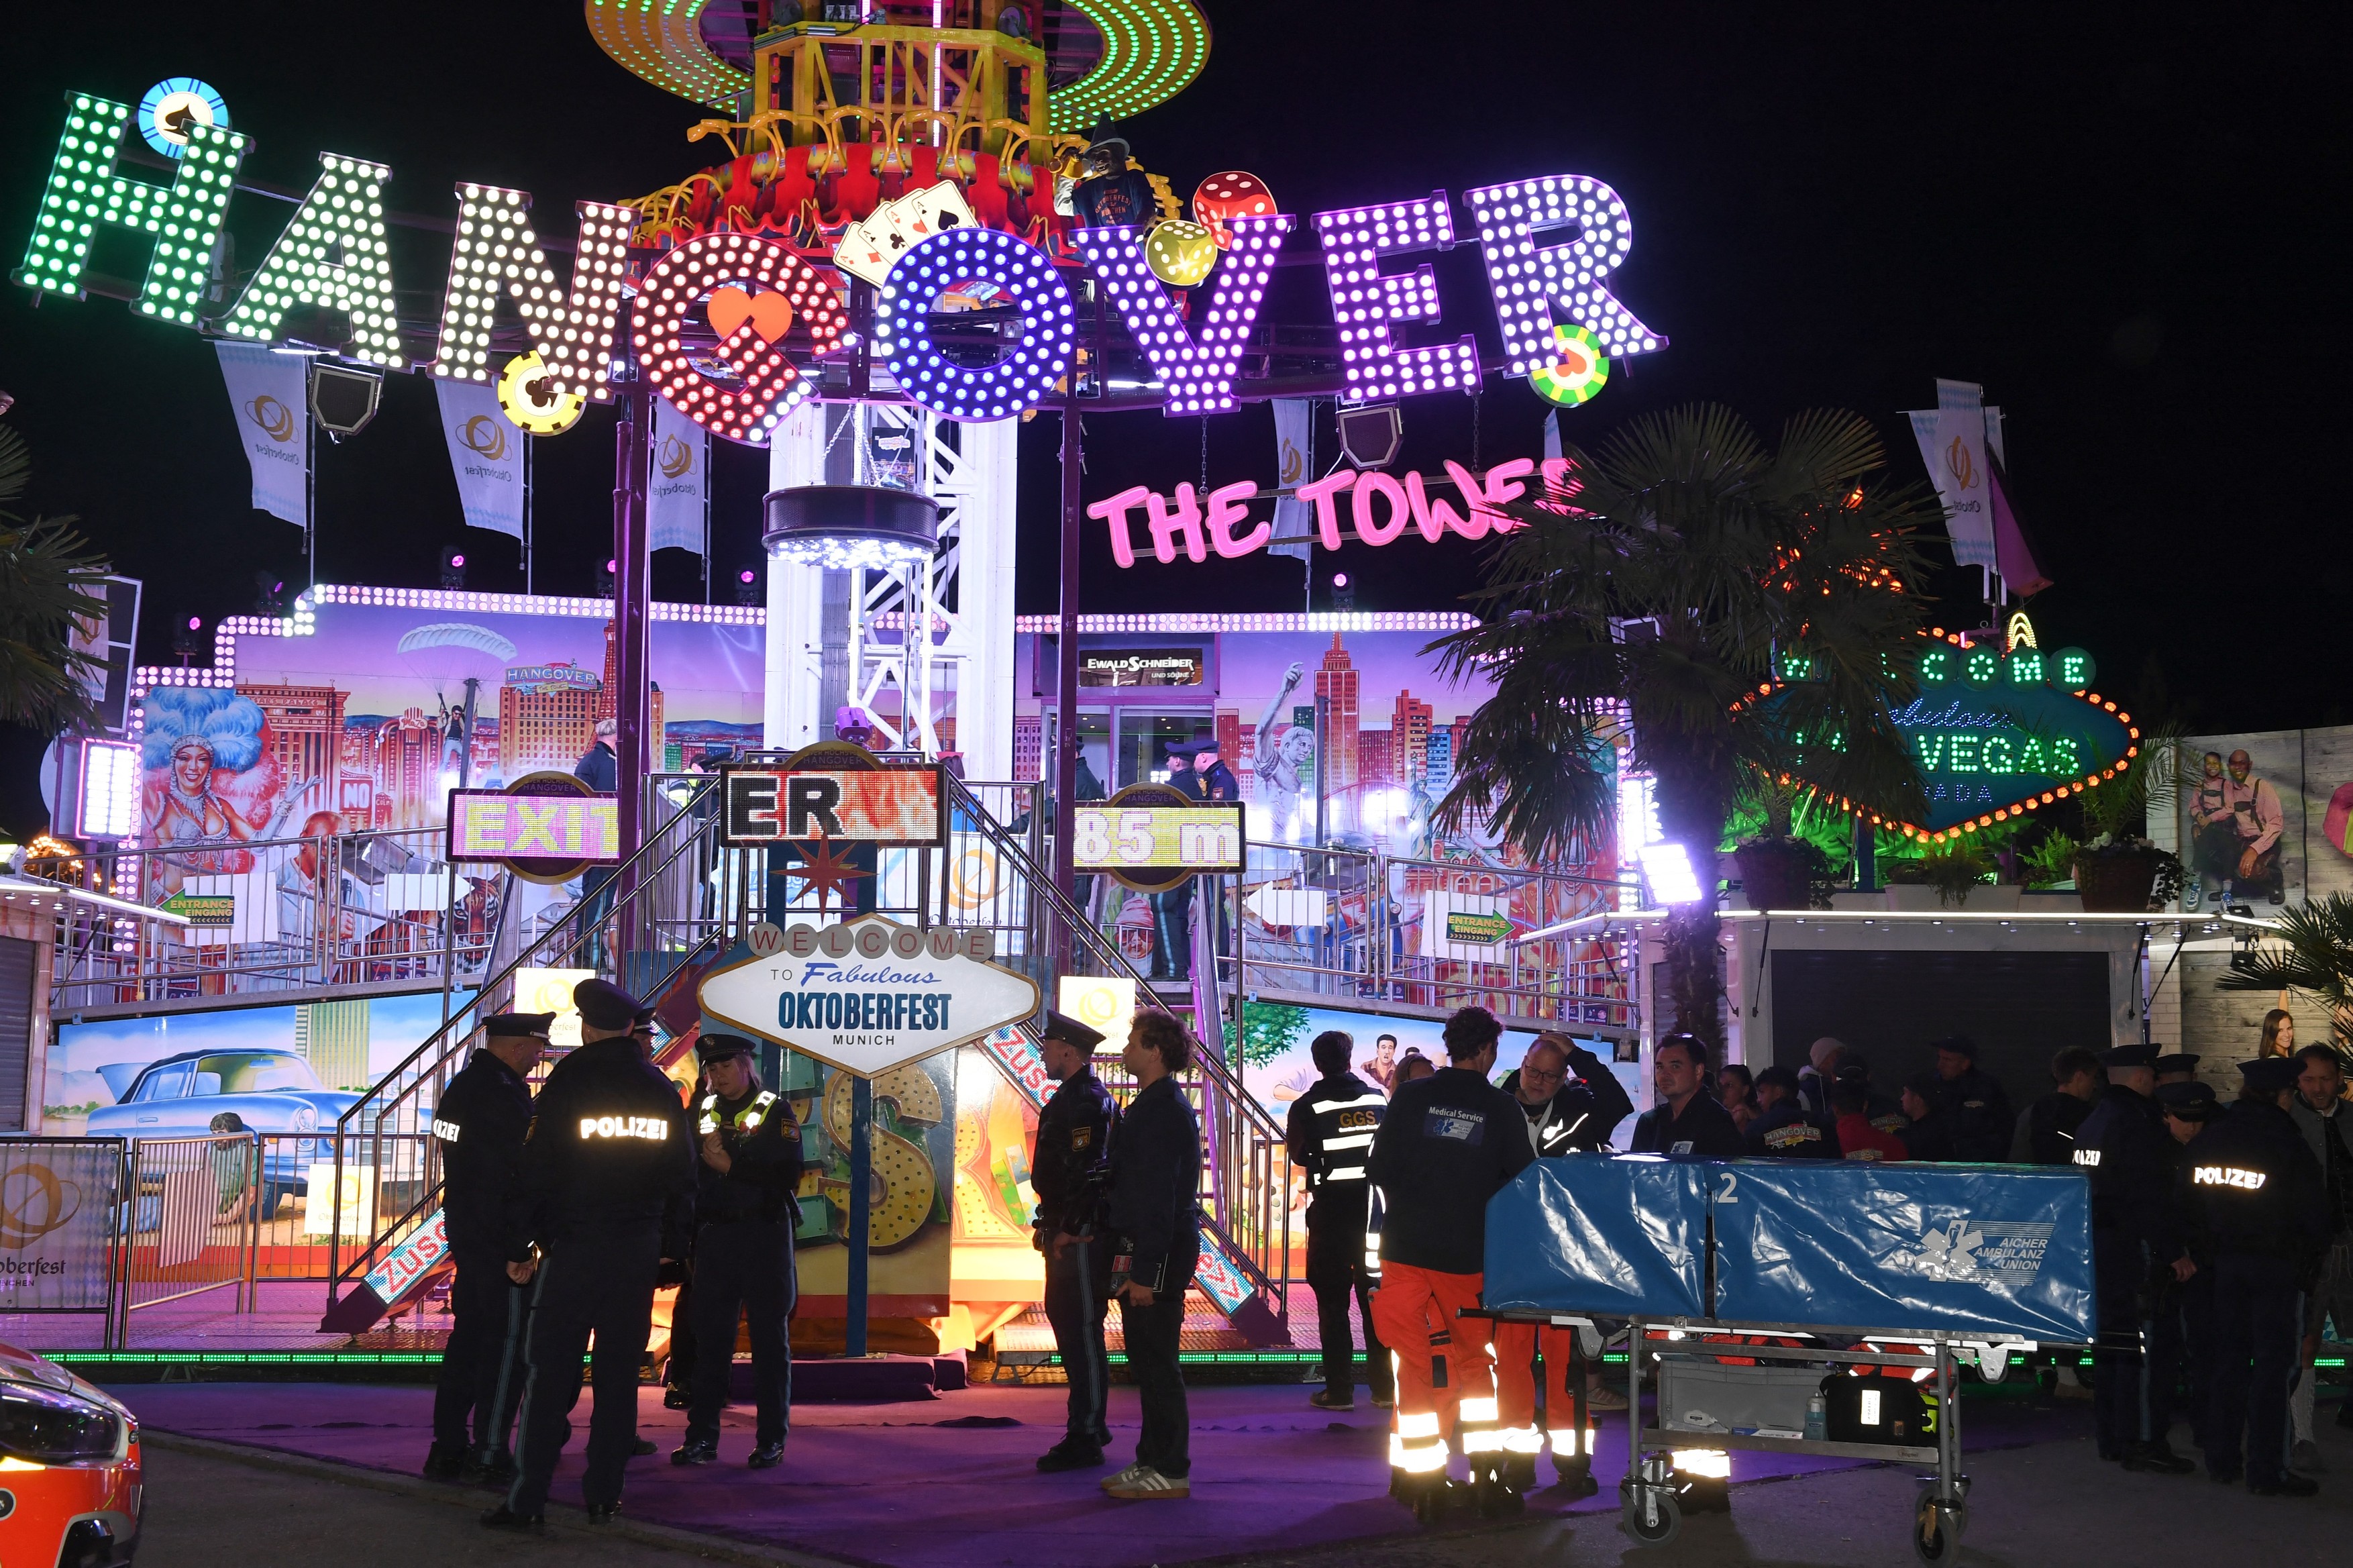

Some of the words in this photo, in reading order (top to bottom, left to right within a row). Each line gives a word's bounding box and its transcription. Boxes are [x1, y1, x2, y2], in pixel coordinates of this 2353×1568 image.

[917, 201, 925, 209] A
[890, 211, 898, 219] A
[11, 89, 1669, 448] HANGOVER
[1087, 480, 1271, 568] THE
[507, 668, 594, 684] HANGOVER
[804, 756, 862, 764] HANGOVER
[1915, 733, 2081, 776] VEGAS
[344, 782, 368, 808] NO
[465, 802, 619, 853] EXIT
[1074, 811, 1155, 864] 85
[1180, 823, 1240, 864] m
[170, 900, 234, 909] ENTRANCE
[1448, 915, 1506, 929] ENTRANCE
[1455, 926, 1498, 936] EINGANG
[753, 930, 986, 956] WELCOME
[771, 969, 792, 981] TO
[800, 962, 942, 987] Fabulous
[778, 992, 952, 1031] OKTOBERFEST
[833, 1035, 895, 1045] MUNICH
[1339, 1110, 1375, 1127] GGS
[1428, 1106, 1457, 1118] Medical
[1457, 1110, 1483, 1123] Service
[580, 1116, 668, 1140] POLIZEI
[1765, 1127, 1820, 1141] HANGOVER
[2194, 1167, 2266, 1189] POLIZEI
[1718, 1172, 1738, 1203] 2
[1999, 1238, 2048, 1249] AICHER
[1975, 1248, 2046, 1259] AMBULANZ
[2001, 1260, 2041, 1271] UNION
